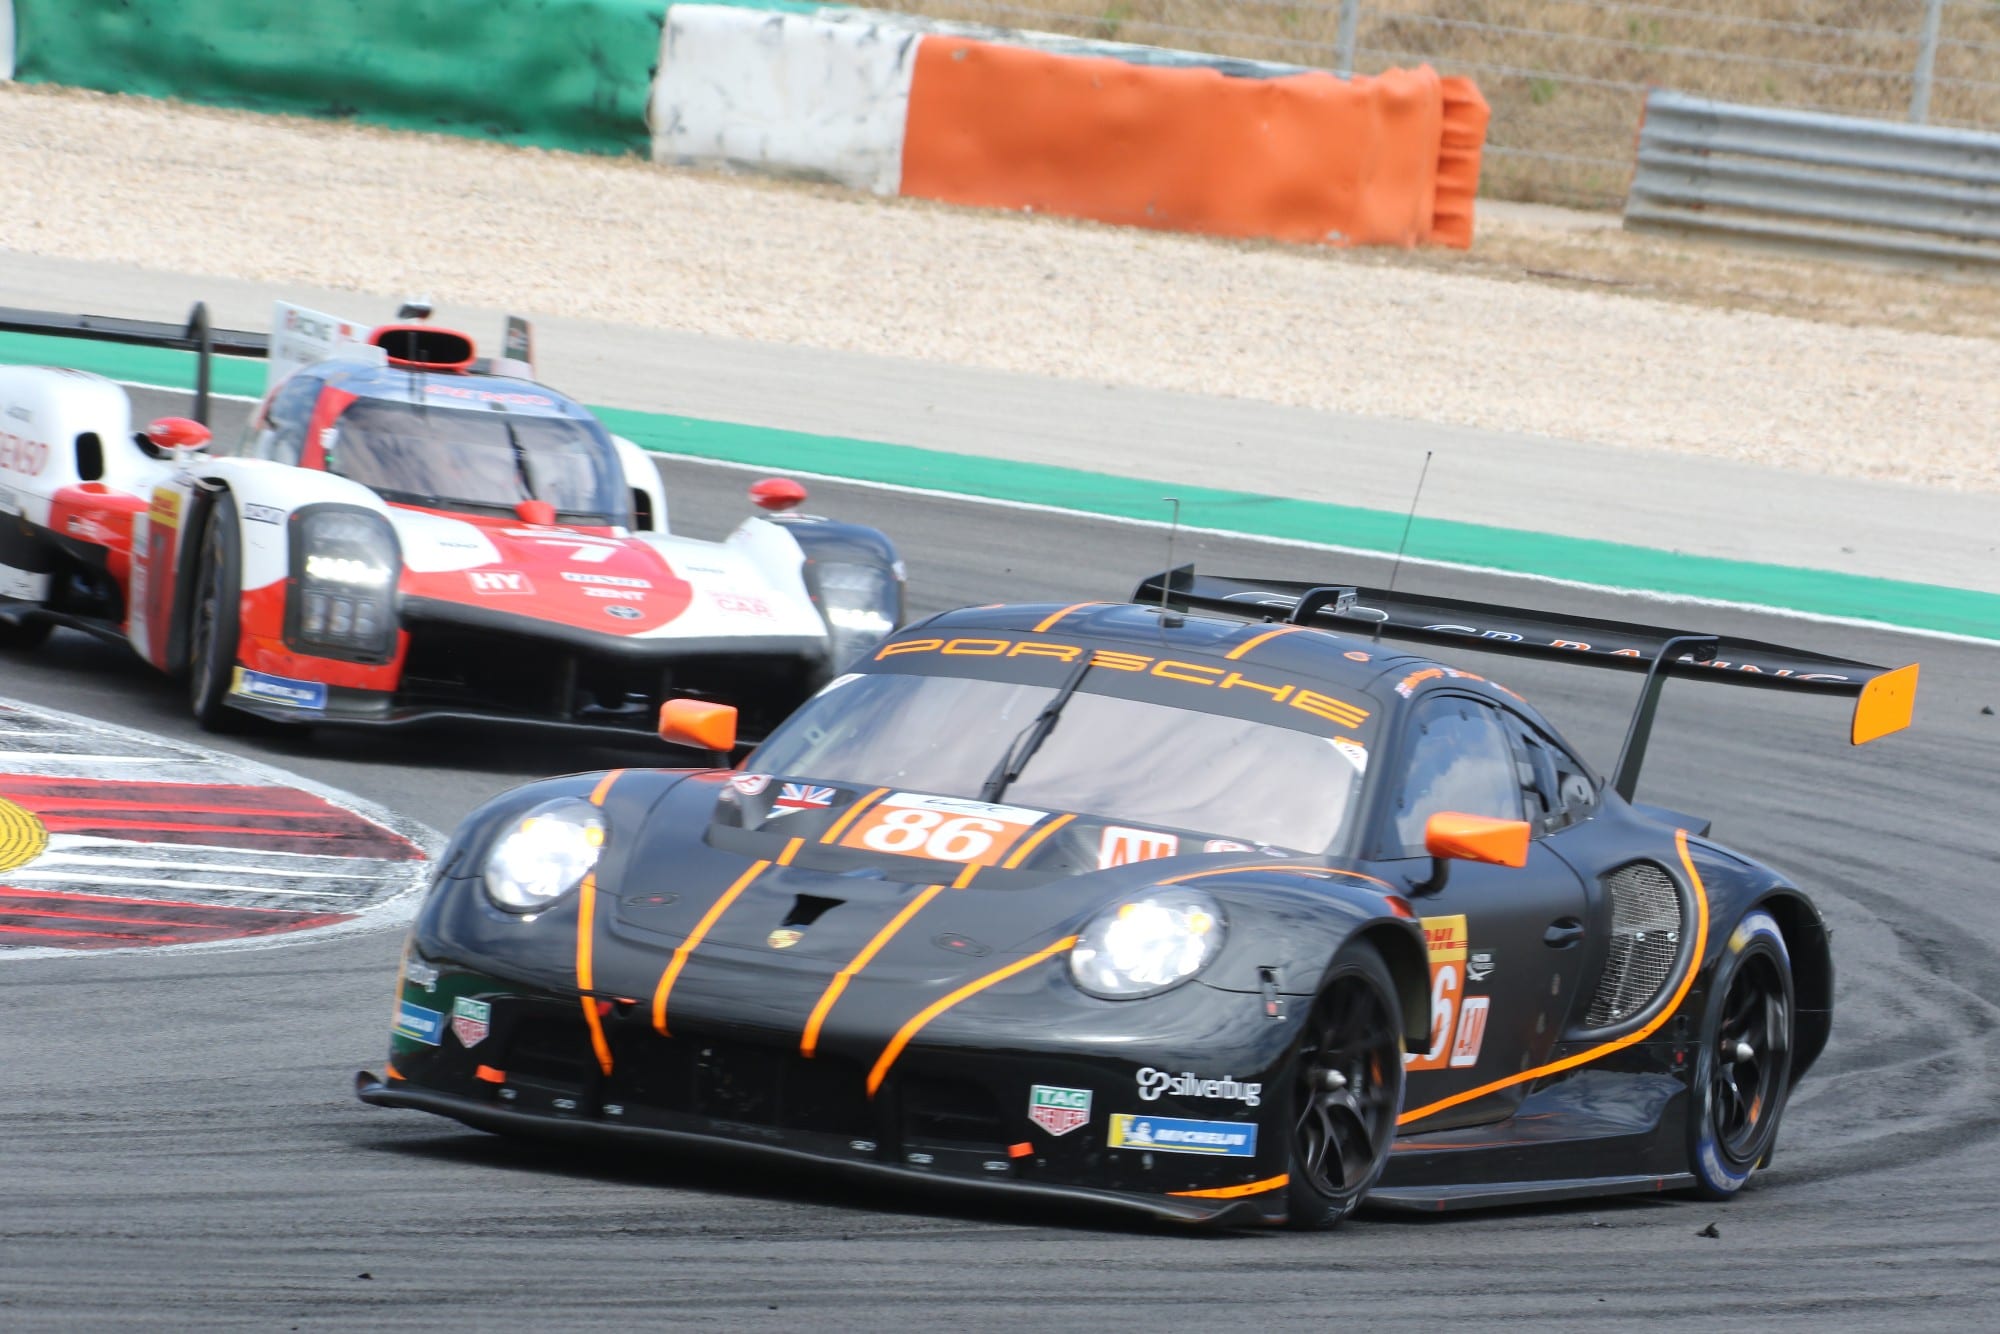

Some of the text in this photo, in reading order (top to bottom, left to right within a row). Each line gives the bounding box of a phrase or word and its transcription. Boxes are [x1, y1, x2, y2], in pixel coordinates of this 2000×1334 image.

[469, 572, 522, 590] HY
[873, 638, 1371, 729] PORSCHE
[863, 809, 1005, 861] 86
[1038, 1089, 1086, 1108] TAG
[1168, 1072, 1262, 1106] silverbug
[1035, 1107, 1087, 1133] HEUER
[1153, 1128, 1248, 1146] MICHELIN
